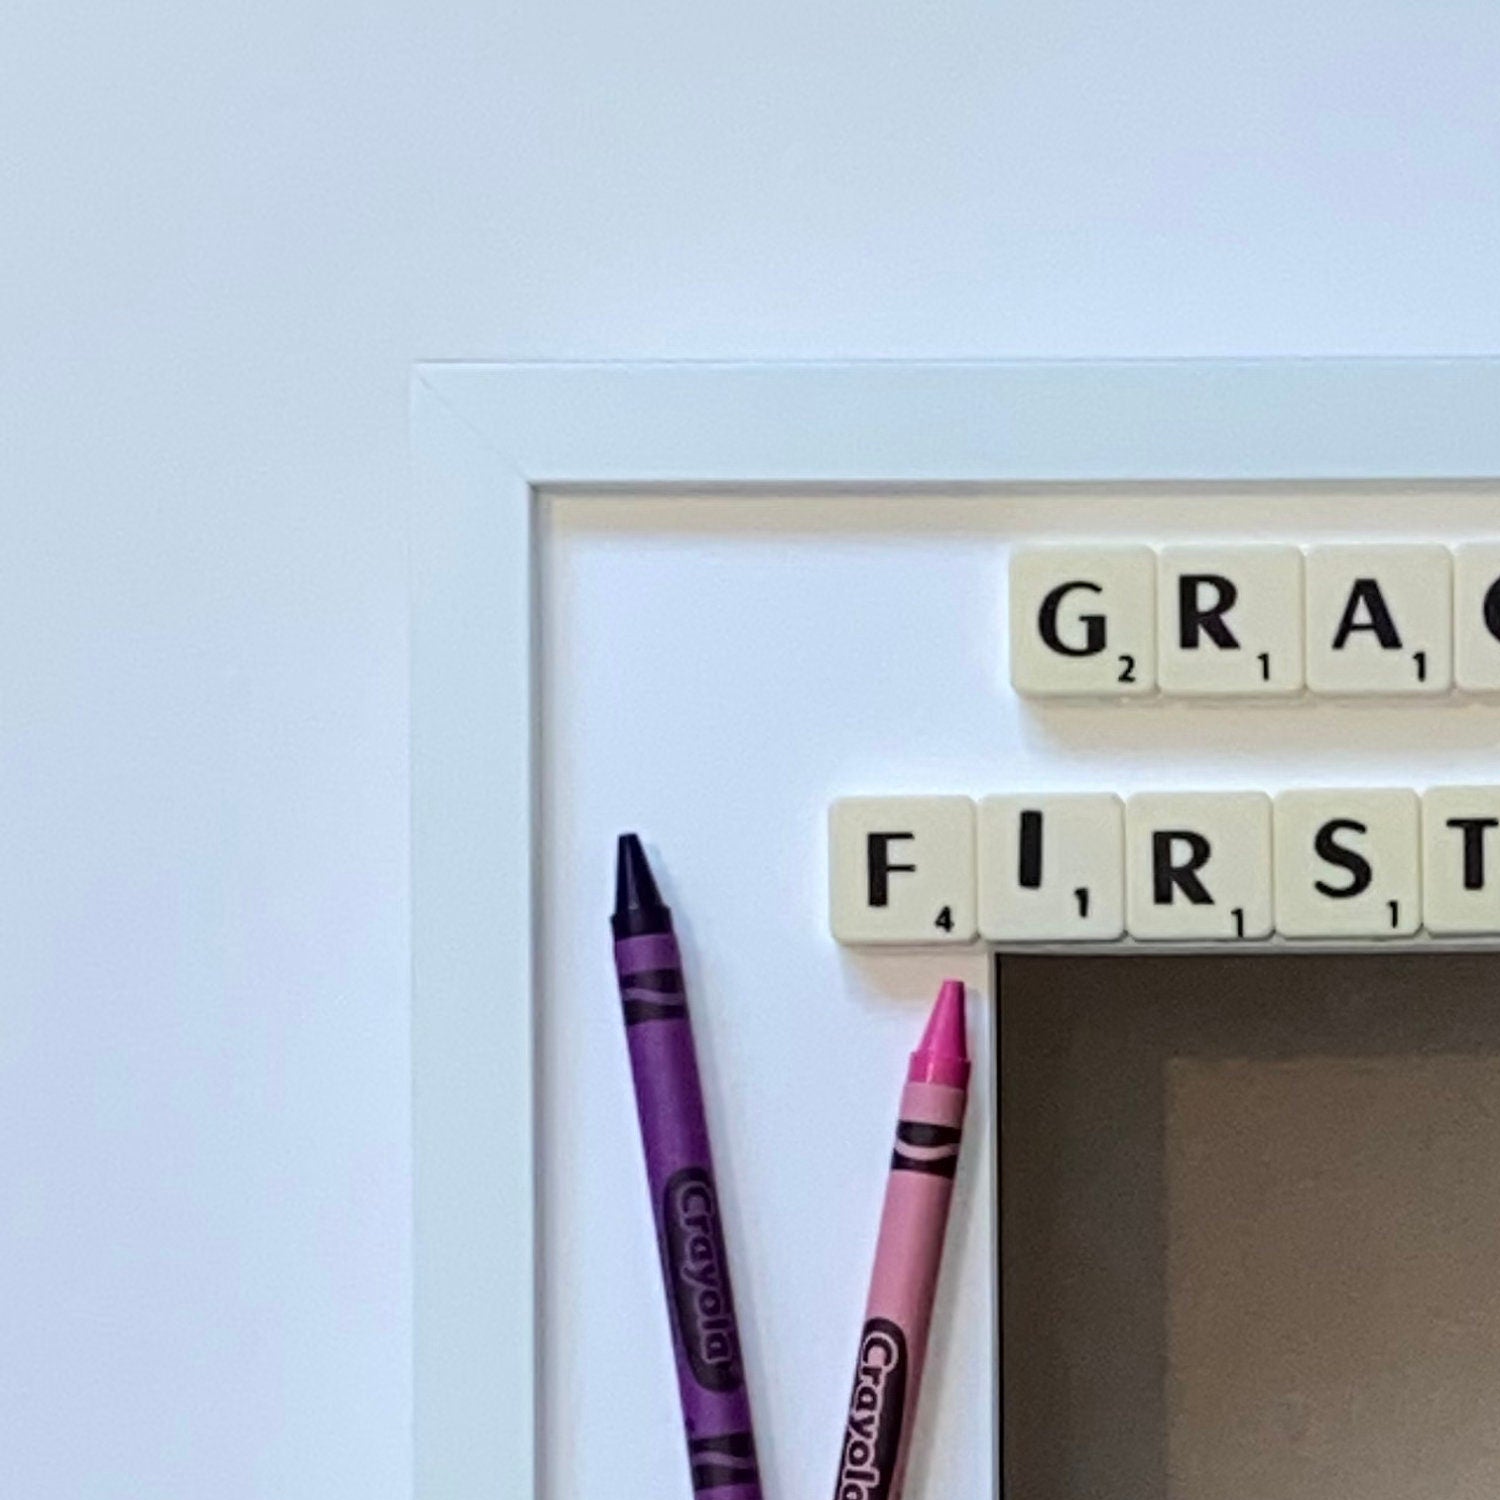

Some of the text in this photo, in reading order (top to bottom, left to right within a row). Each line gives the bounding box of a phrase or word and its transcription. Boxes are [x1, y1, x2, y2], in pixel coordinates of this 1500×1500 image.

[1117, 654, 1136, 683] 2
[1256, 652, 1271, 682] 1
[1410, 651, 1426, 682] 1
[866, 808, 1500, 909] FIRST
[933, 905, 955, 934] 4
[1073, 886, 1090, 918] 1
[1228, 908, 1245, 939] 1
[1385, 900, 1400, 929] 1
[680, 1180, 733, 1364] Crayola
